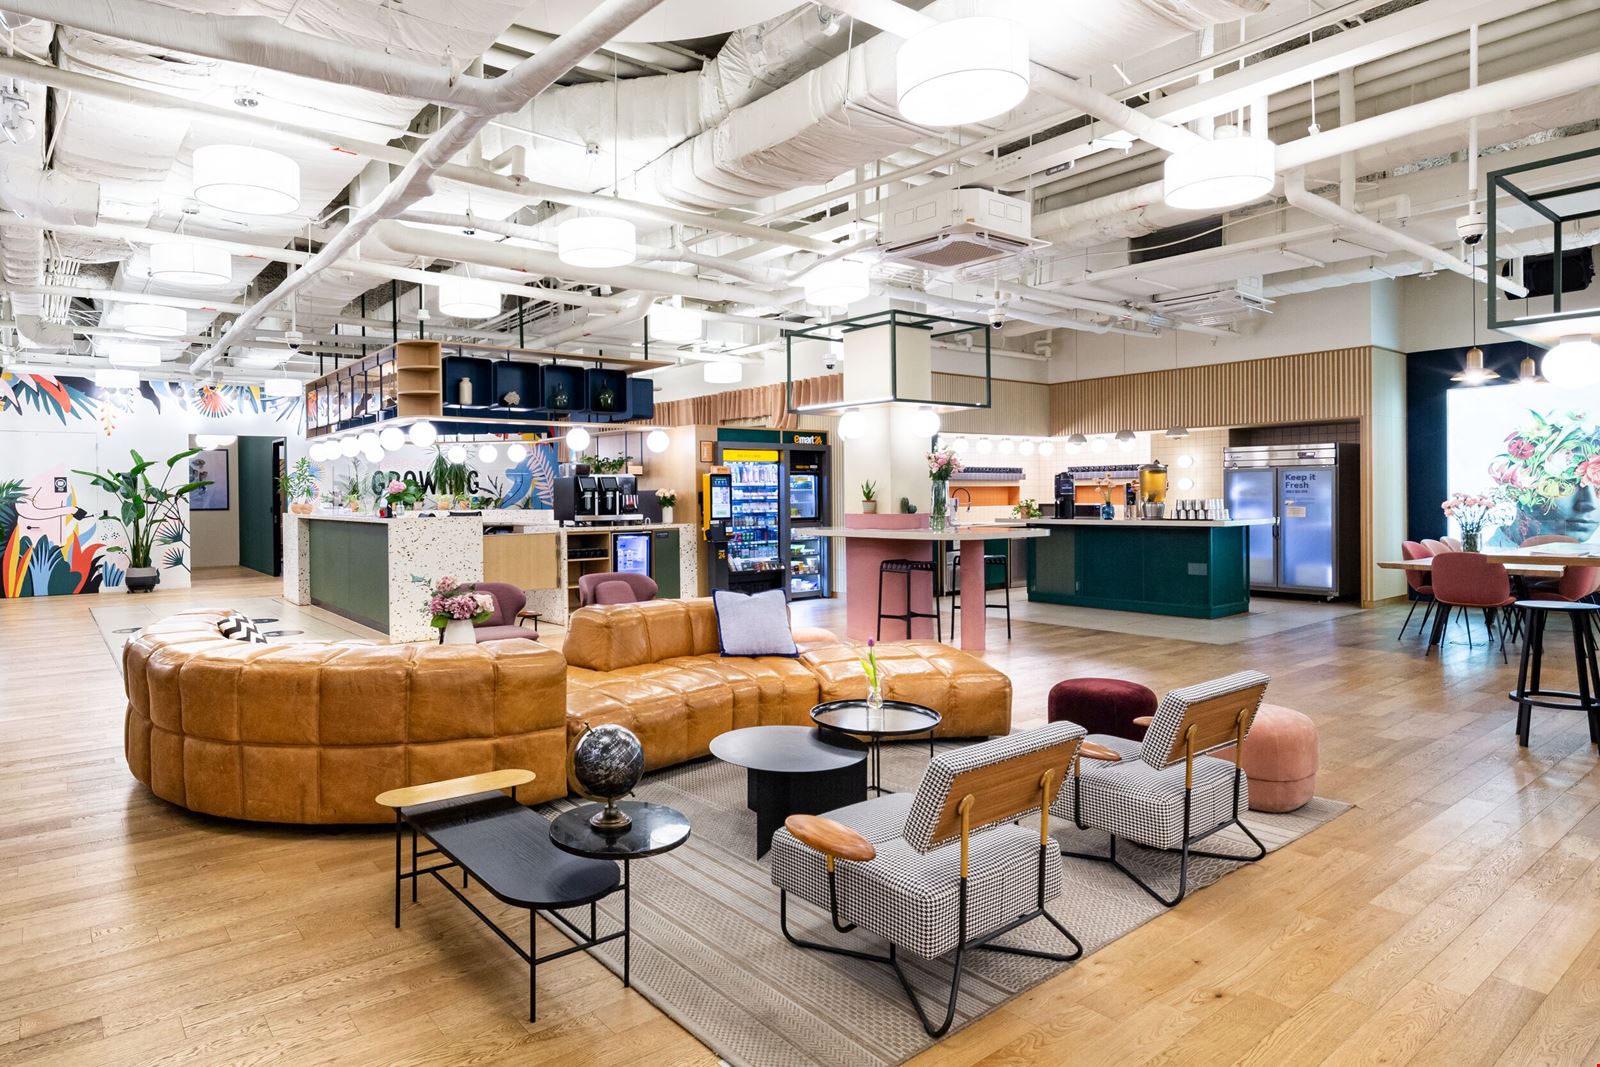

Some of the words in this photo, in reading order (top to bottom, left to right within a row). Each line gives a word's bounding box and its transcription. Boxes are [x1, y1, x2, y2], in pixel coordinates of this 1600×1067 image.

[372, 470, 479, 495] GRWG
[1285, 474, 1307, 482] Keep
[1309, 473, 1316, 481] it
